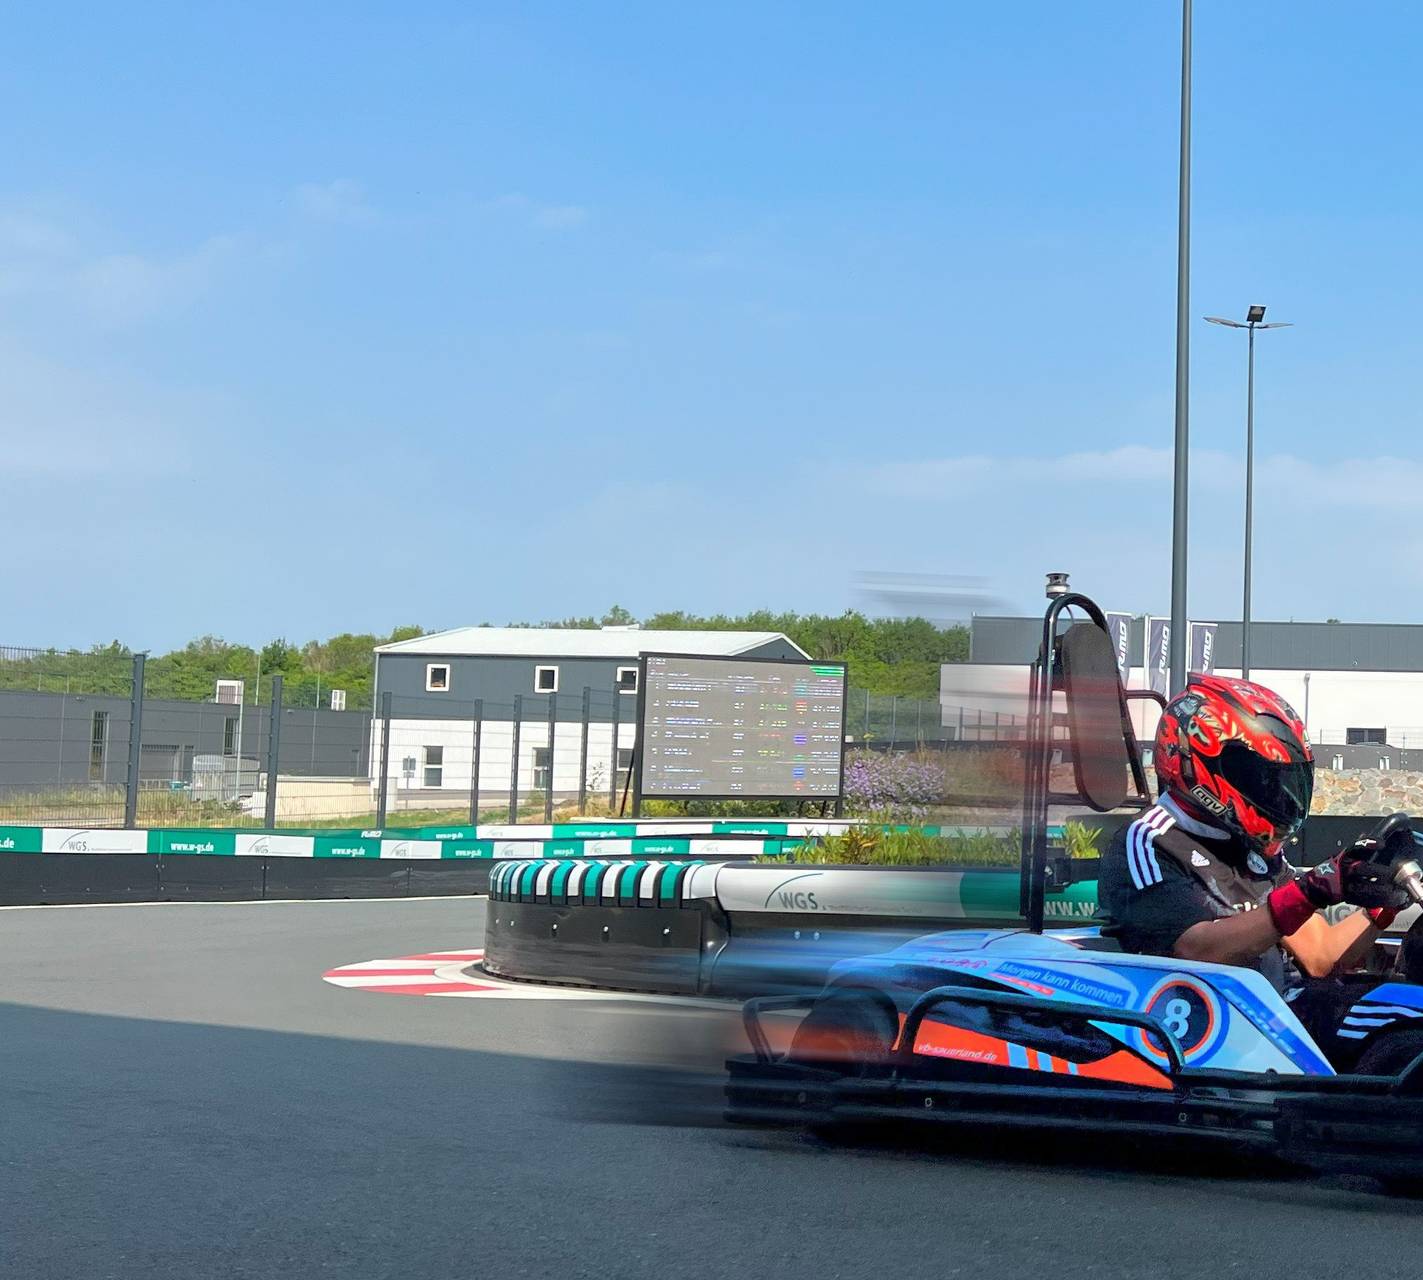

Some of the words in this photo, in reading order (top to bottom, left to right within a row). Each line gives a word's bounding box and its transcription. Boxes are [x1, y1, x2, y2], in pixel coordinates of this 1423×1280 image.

[1000, 962, 1041, 981] Morgen
[1043, 970, 1069, 989] kann
[1071, 977, 1125, 1006] kommen.
[1162, 997, 1192, 1039] 8
[917, 1042, 998, 1062] vb-sauerland.de
